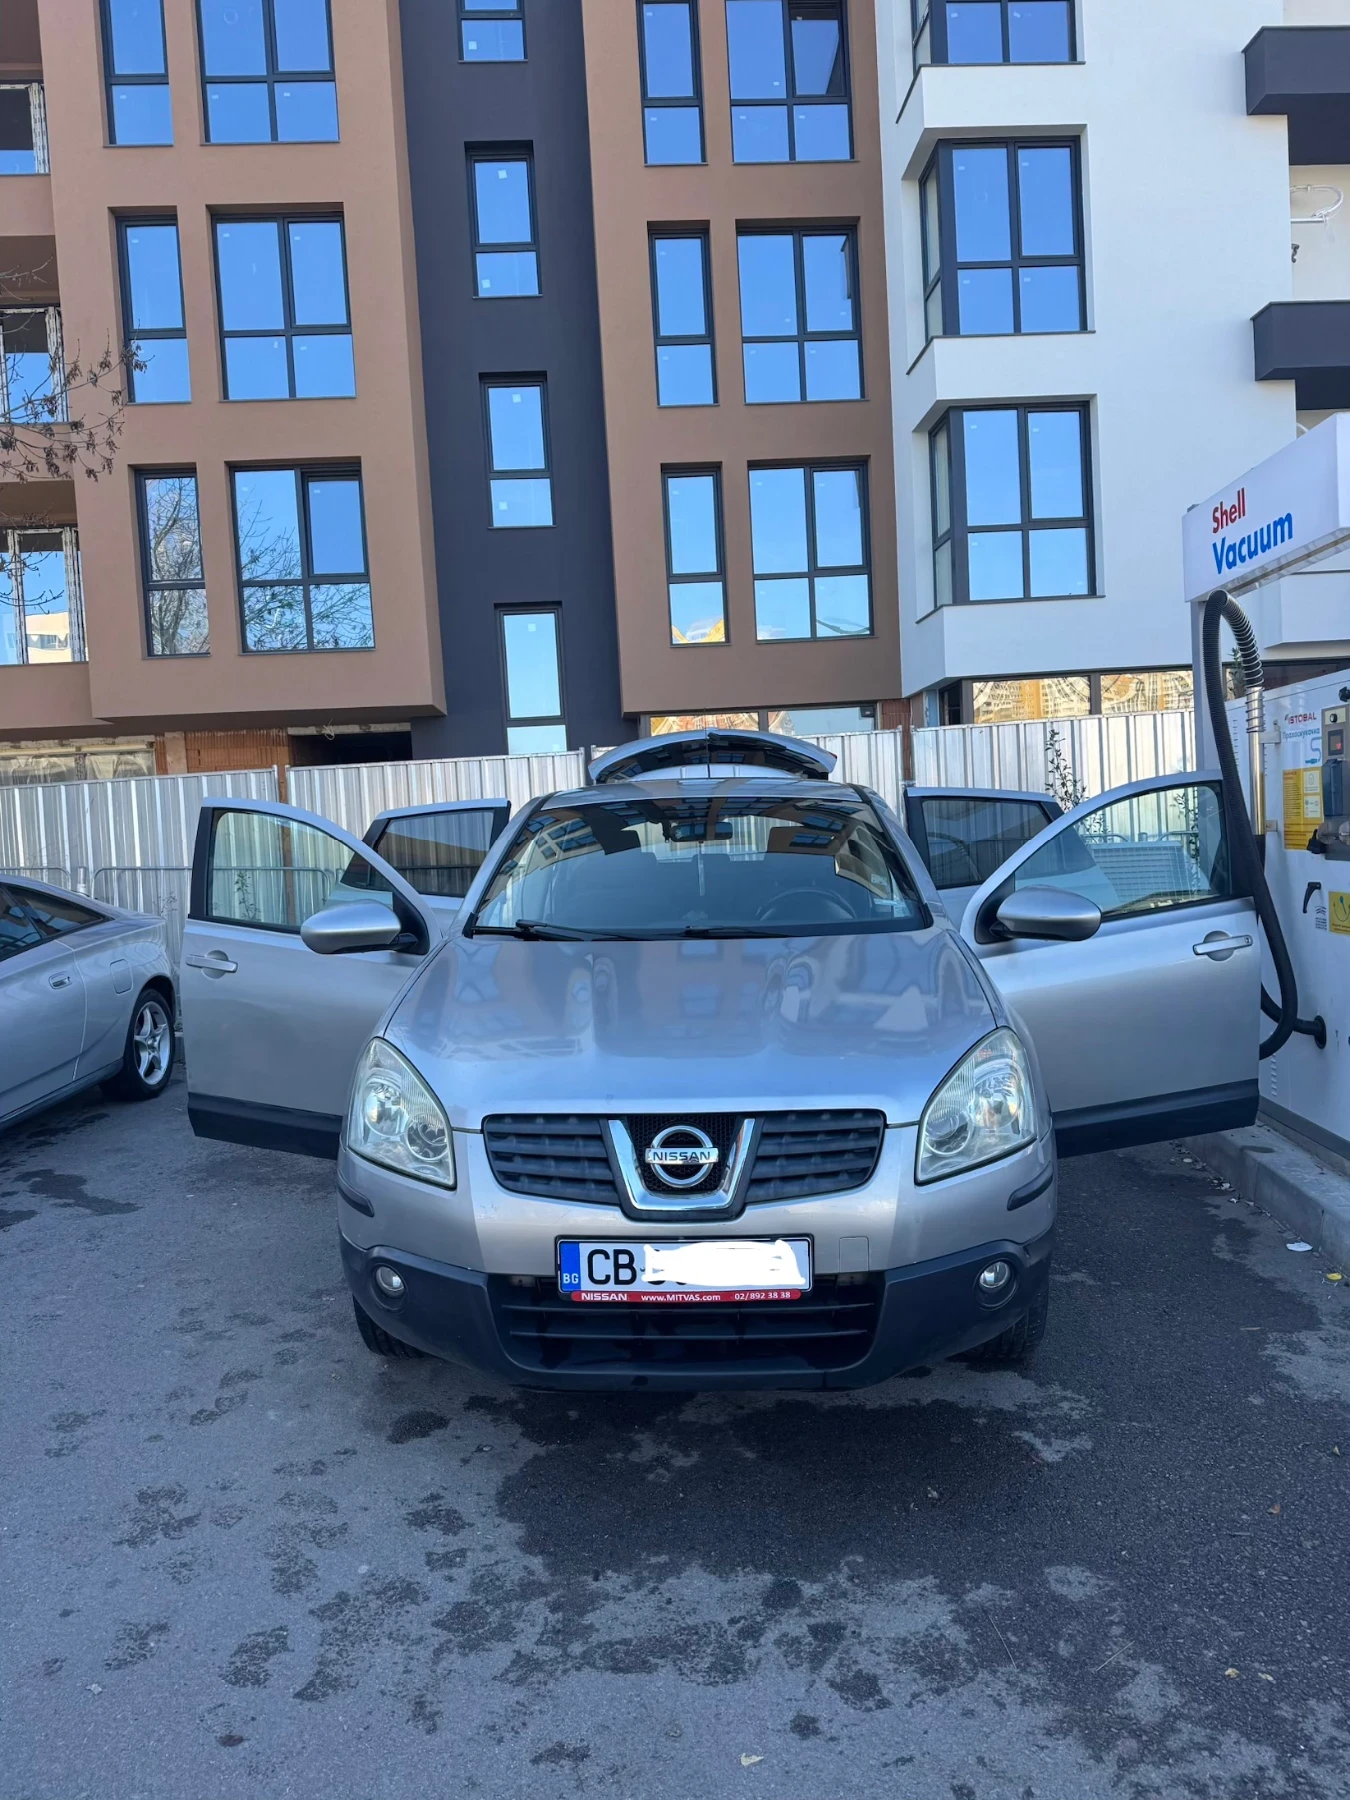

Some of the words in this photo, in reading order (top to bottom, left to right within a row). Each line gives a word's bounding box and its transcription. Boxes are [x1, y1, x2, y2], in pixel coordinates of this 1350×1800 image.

[1212, 487, 1247, 534] Shell
[1212, 512, 1293, 575] Vacuum
[652, 1151, 711, 1161] NISSAN
[563, 1273, 579, 1284] BG
[581, 1292, 628, 1301] NISSAN
[641, 1293, 721, 1302] www.MITVAS.com
[734, 1292, 766, 1301] 02/892
[767, 1291, 779, 1299] 38
[780, 1291, 791, 1299] 38
